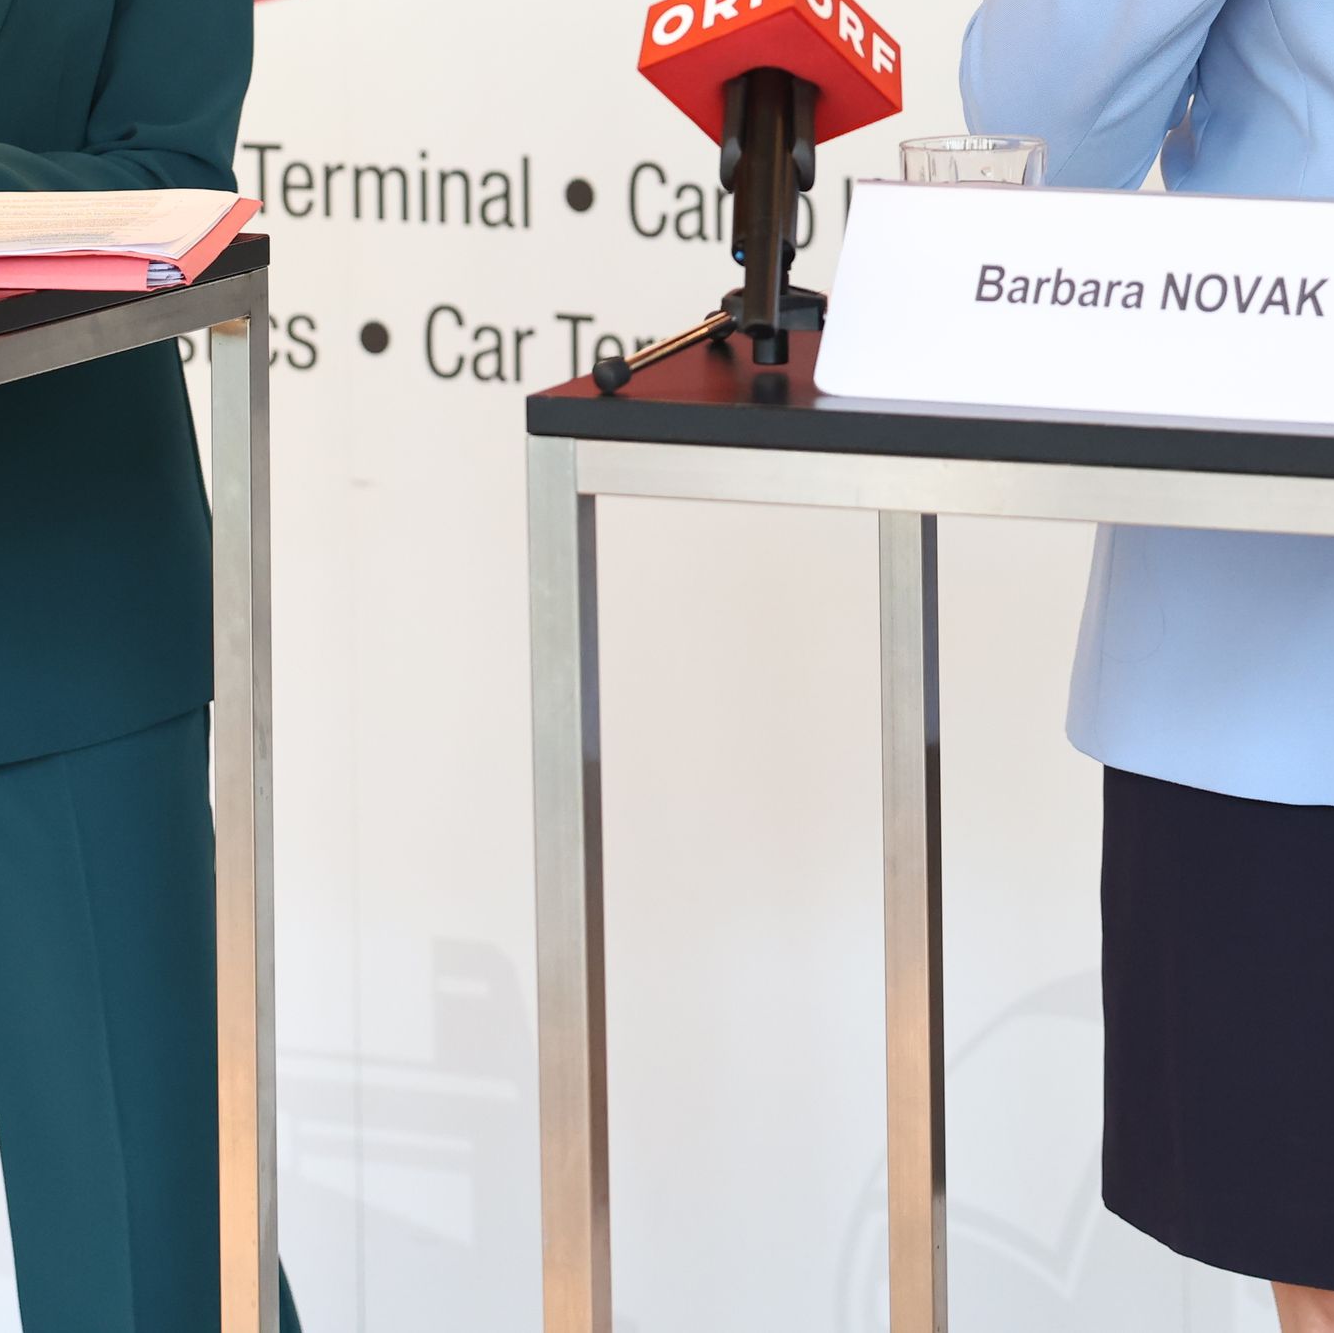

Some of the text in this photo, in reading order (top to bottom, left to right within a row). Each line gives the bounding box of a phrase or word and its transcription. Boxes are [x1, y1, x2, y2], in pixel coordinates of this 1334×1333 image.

[241, 143, 532, 229] Terminal
[973, 263, 1330, 318] Barbara NOVAK
[423, 304, 537, 383] Car
